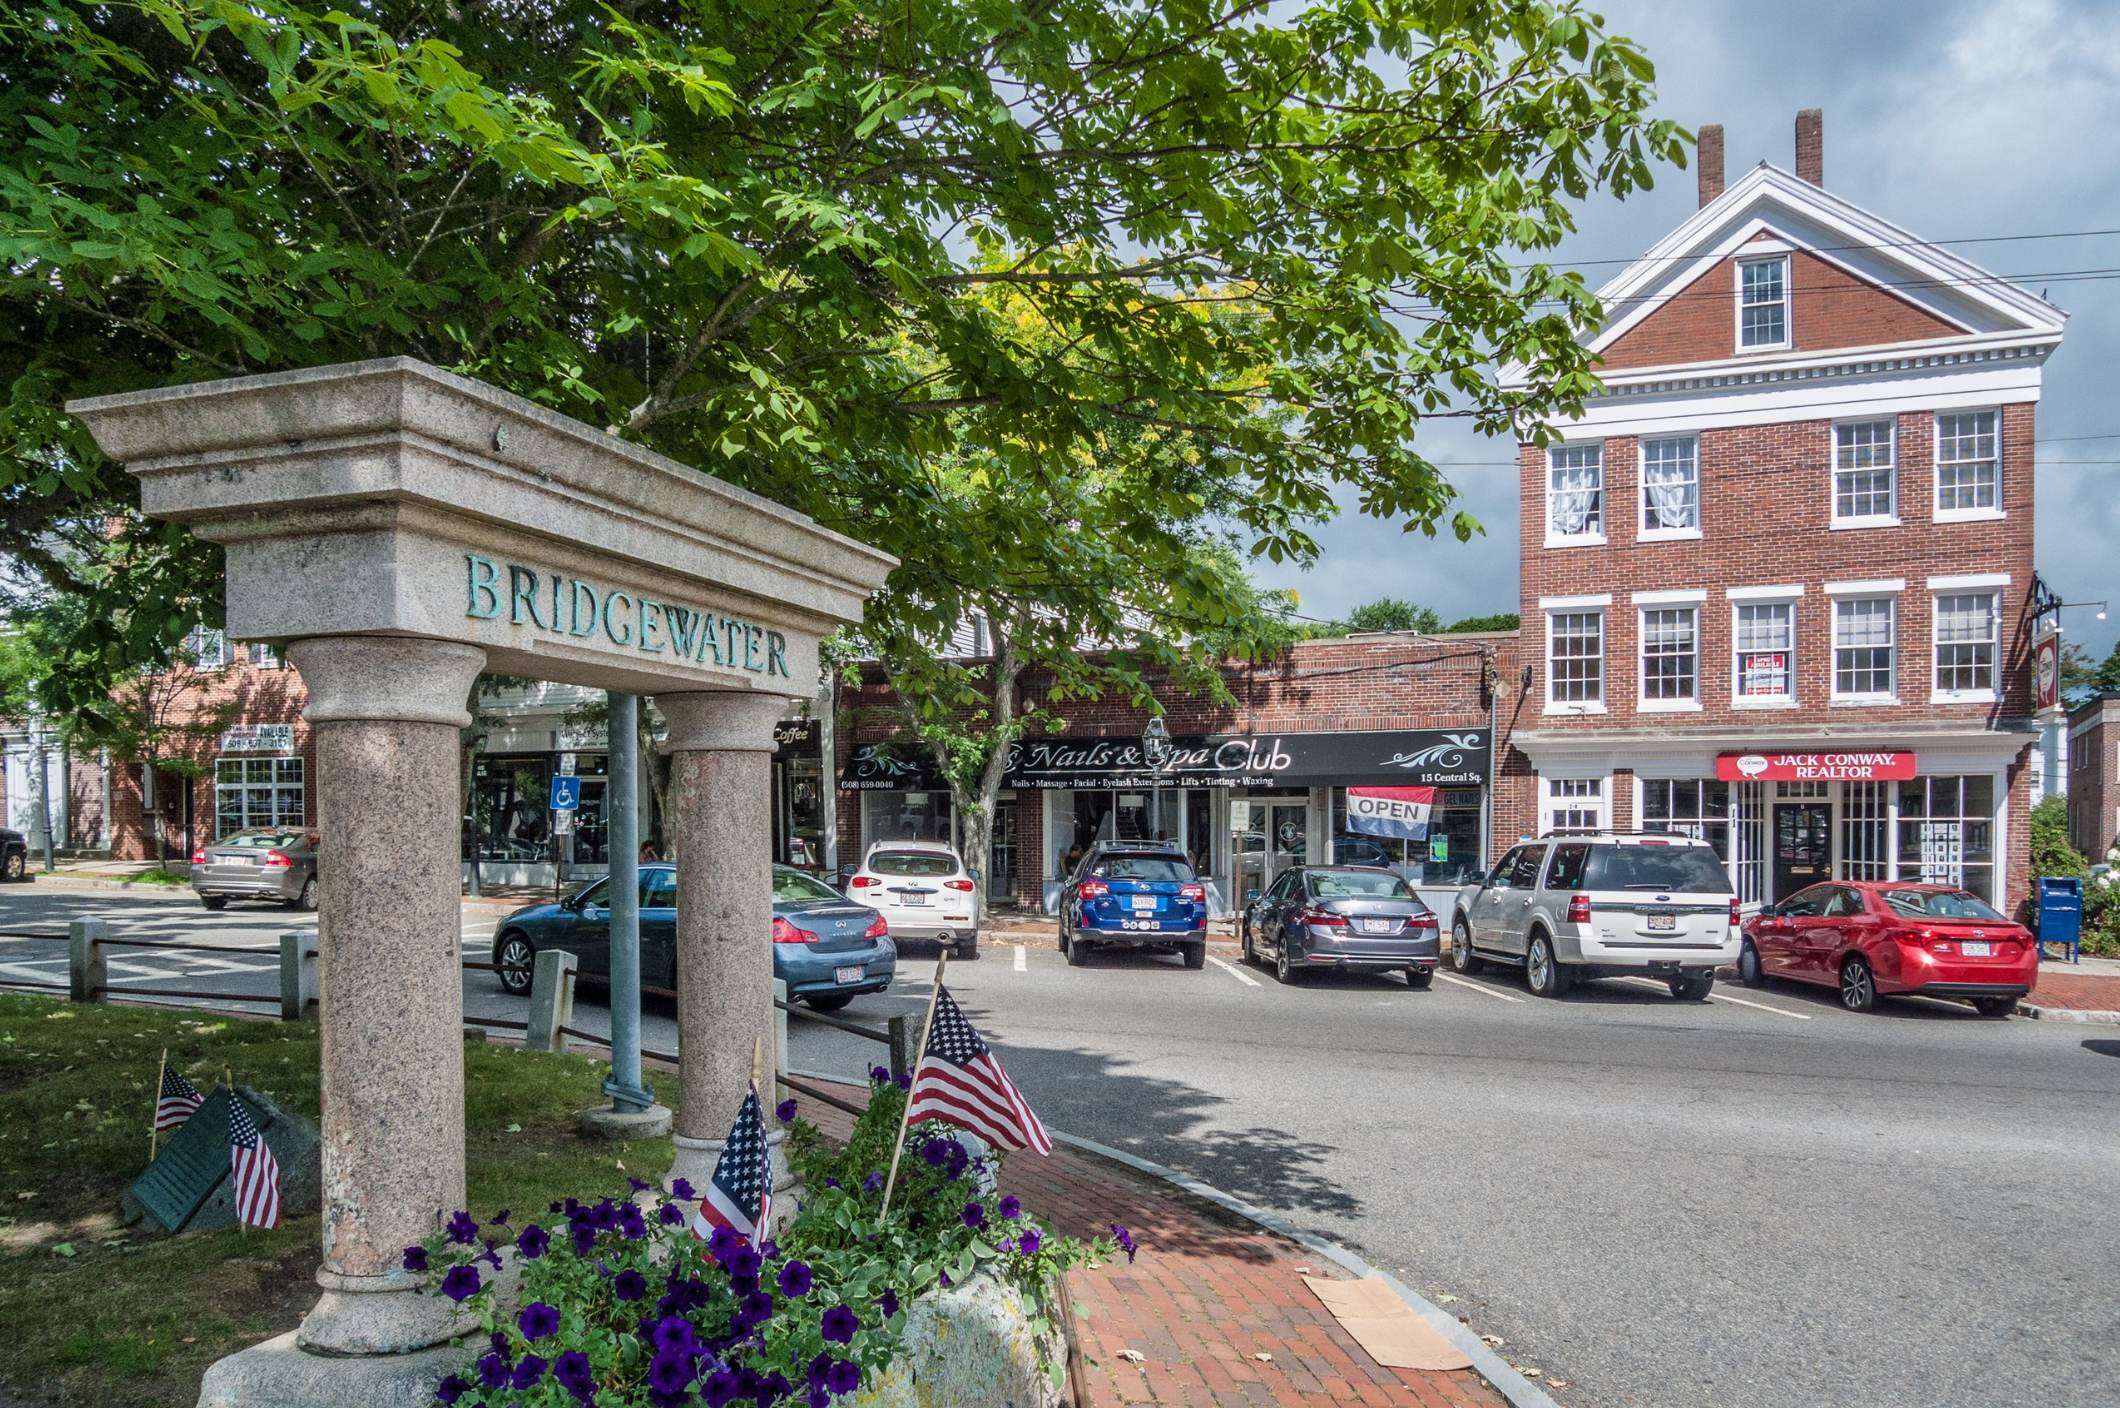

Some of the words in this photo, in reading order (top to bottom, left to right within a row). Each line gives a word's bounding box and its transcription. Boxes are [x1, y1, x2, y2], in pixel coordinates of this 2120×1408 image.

[466, 554, 790, 678] BRIDGEWATER
[774, 727, 809, 744] Coffee
[1024, 742, 1113, 767] Nails
[1115, 746, 1142, 765] &
[1214, 738, 1292, 771] Club
[1773, 754, 1819, 766] JACK
[1421, 773, 1433, 783] 15
[1434, 772, 1467, 782] Central
[1468, 772, 1482, 783] Sq.
[1796, 766, 1873, 778] REALTOR
[841, 780, 859, 789] (508)
[860, 780, 894, 789] 659-0040
[1036, 780, 1068, 788] Massage
[1073, 779, 1096, 787] Facial
[1102, 778, 1131, 788] Eyelash
[1181, 776, 1199, 786] Lifts
[1205, 776, 1236, 787] Tinting
[1242, 776, 1274, 787] Waxing
[1358, 799, 1419, 820] OPEN
